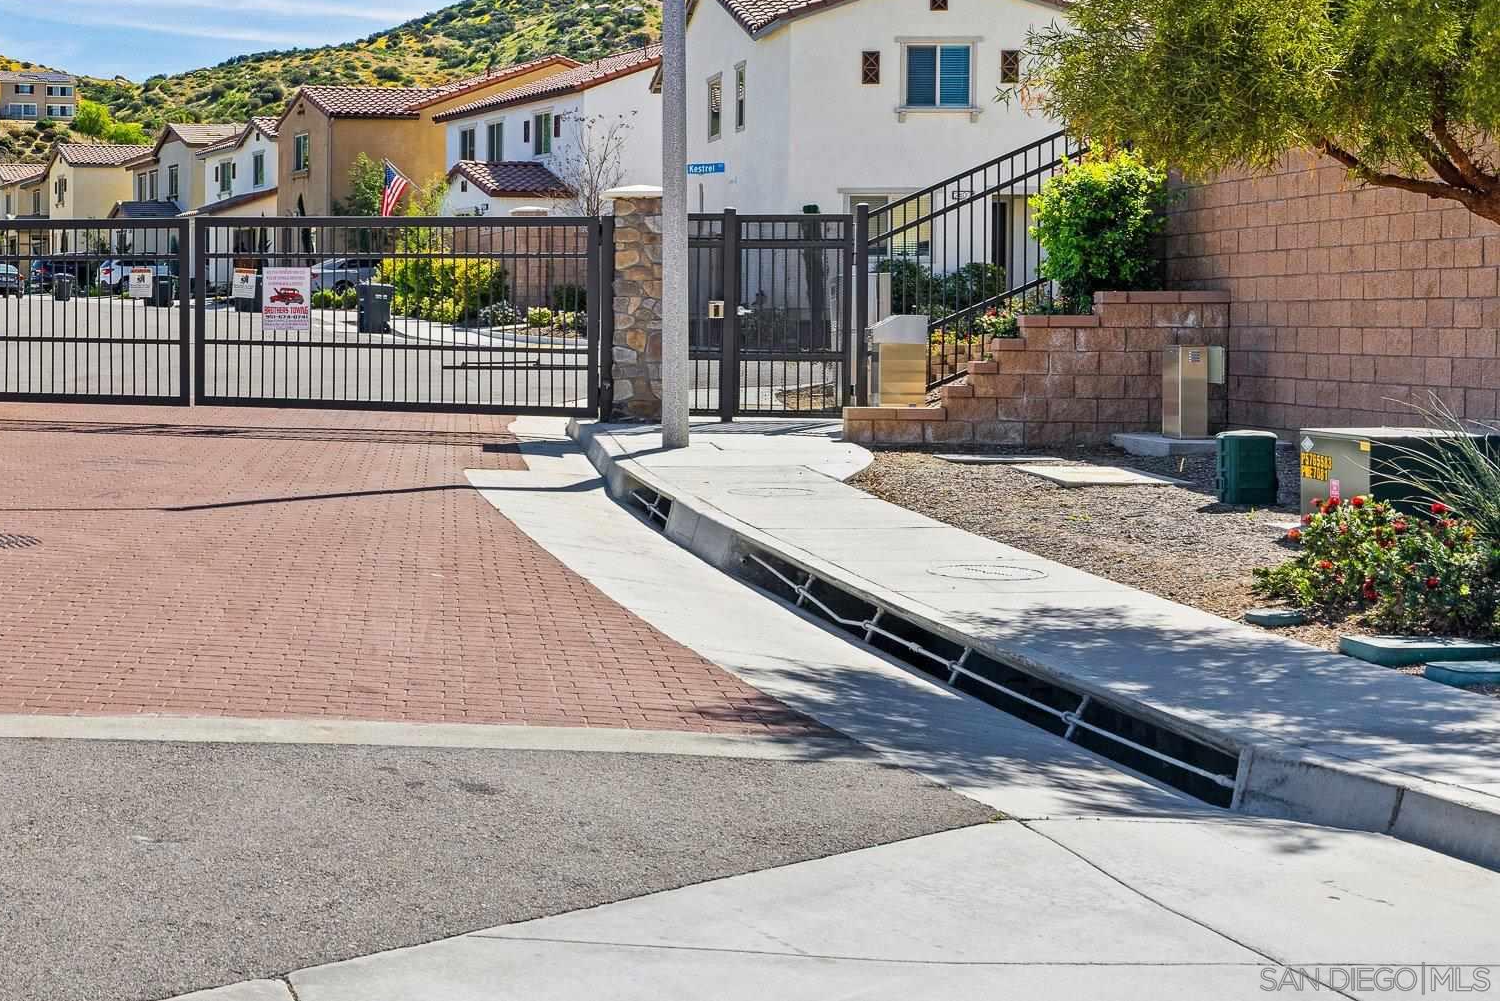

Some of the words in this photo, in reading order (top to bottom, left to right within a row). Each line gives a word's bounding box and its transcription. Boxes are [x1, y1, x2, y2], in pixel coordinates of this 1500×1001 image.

[689, 165, 715, 173] Kestrel
[264, 306, 289, 314] BROTHERS
[290, 306, 309, 315] TOWING
